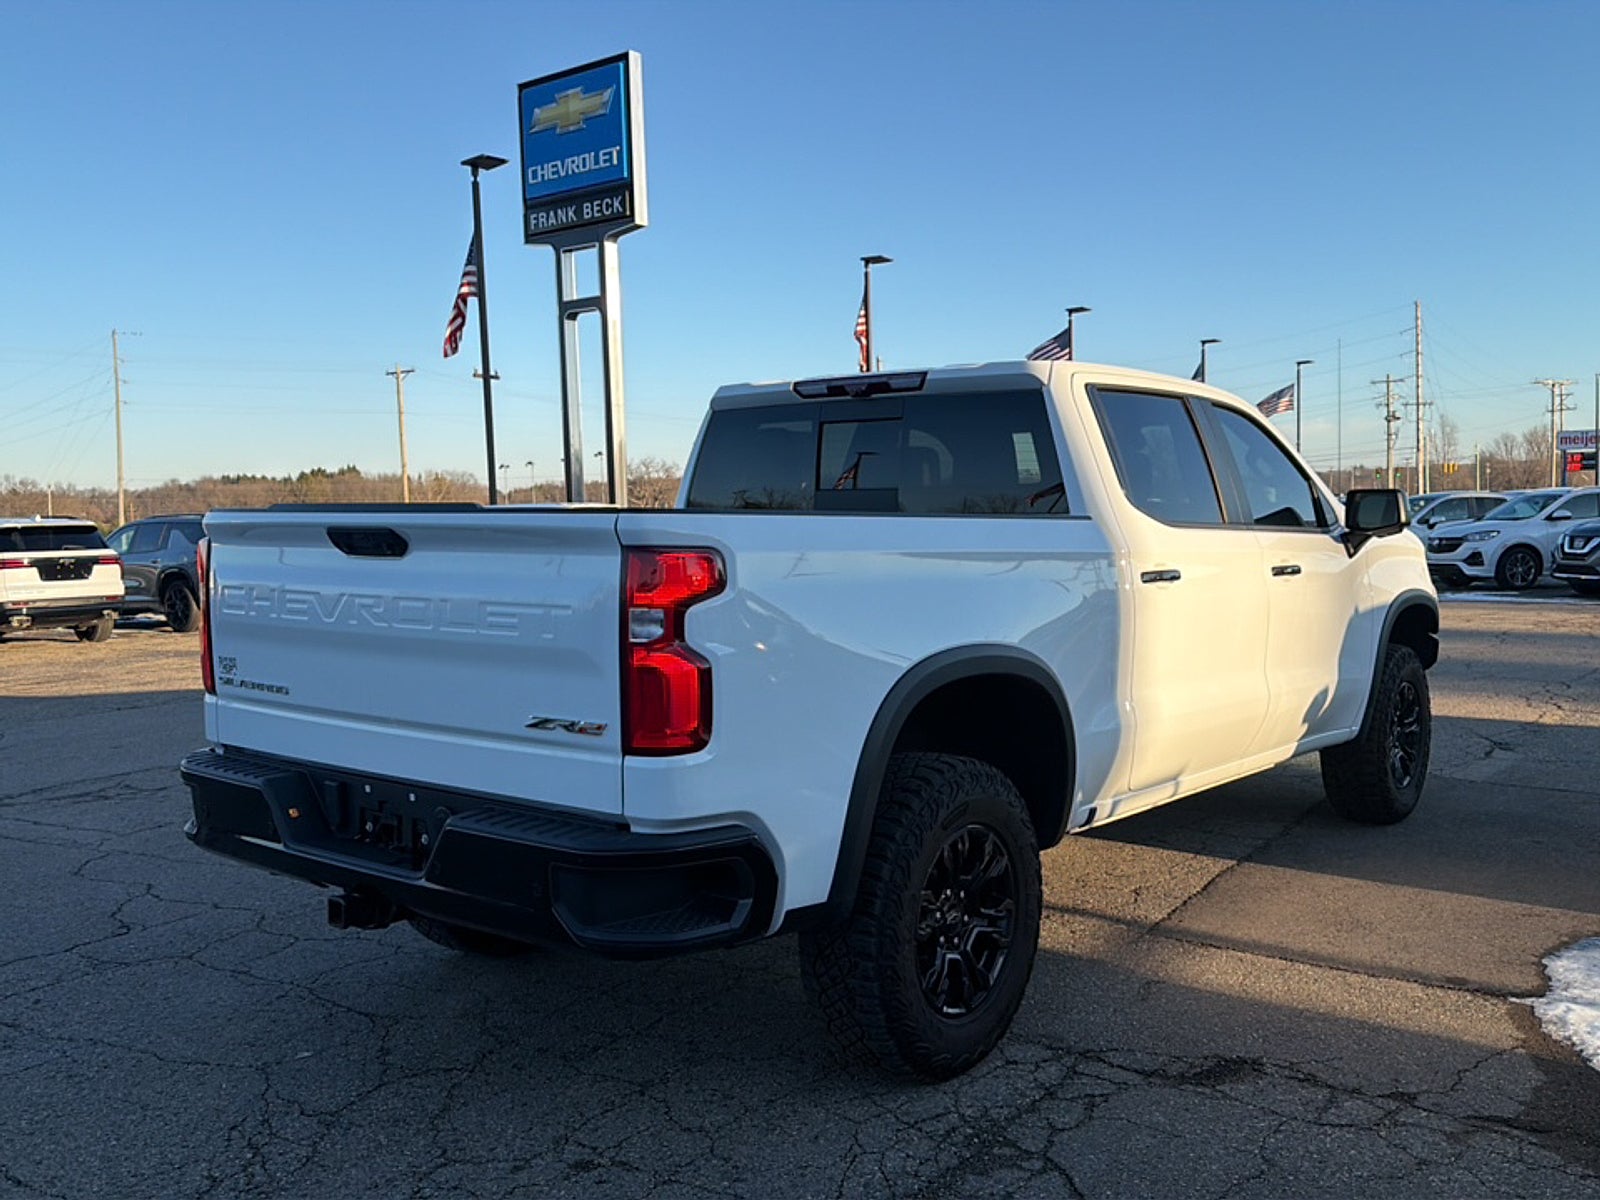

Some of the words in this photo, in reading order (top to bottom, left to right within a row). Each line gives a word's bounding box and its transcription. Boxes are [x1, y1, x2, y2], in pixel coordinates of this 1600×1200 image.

[528, 146, 620, 184] CHEVROLET
[530, 205, 577, 230] FRANK
[583, 195, 623, 219] BECK
[1560, 431, 1600, 449] meije
[219, 585, 573, 639] CHEVROLET
